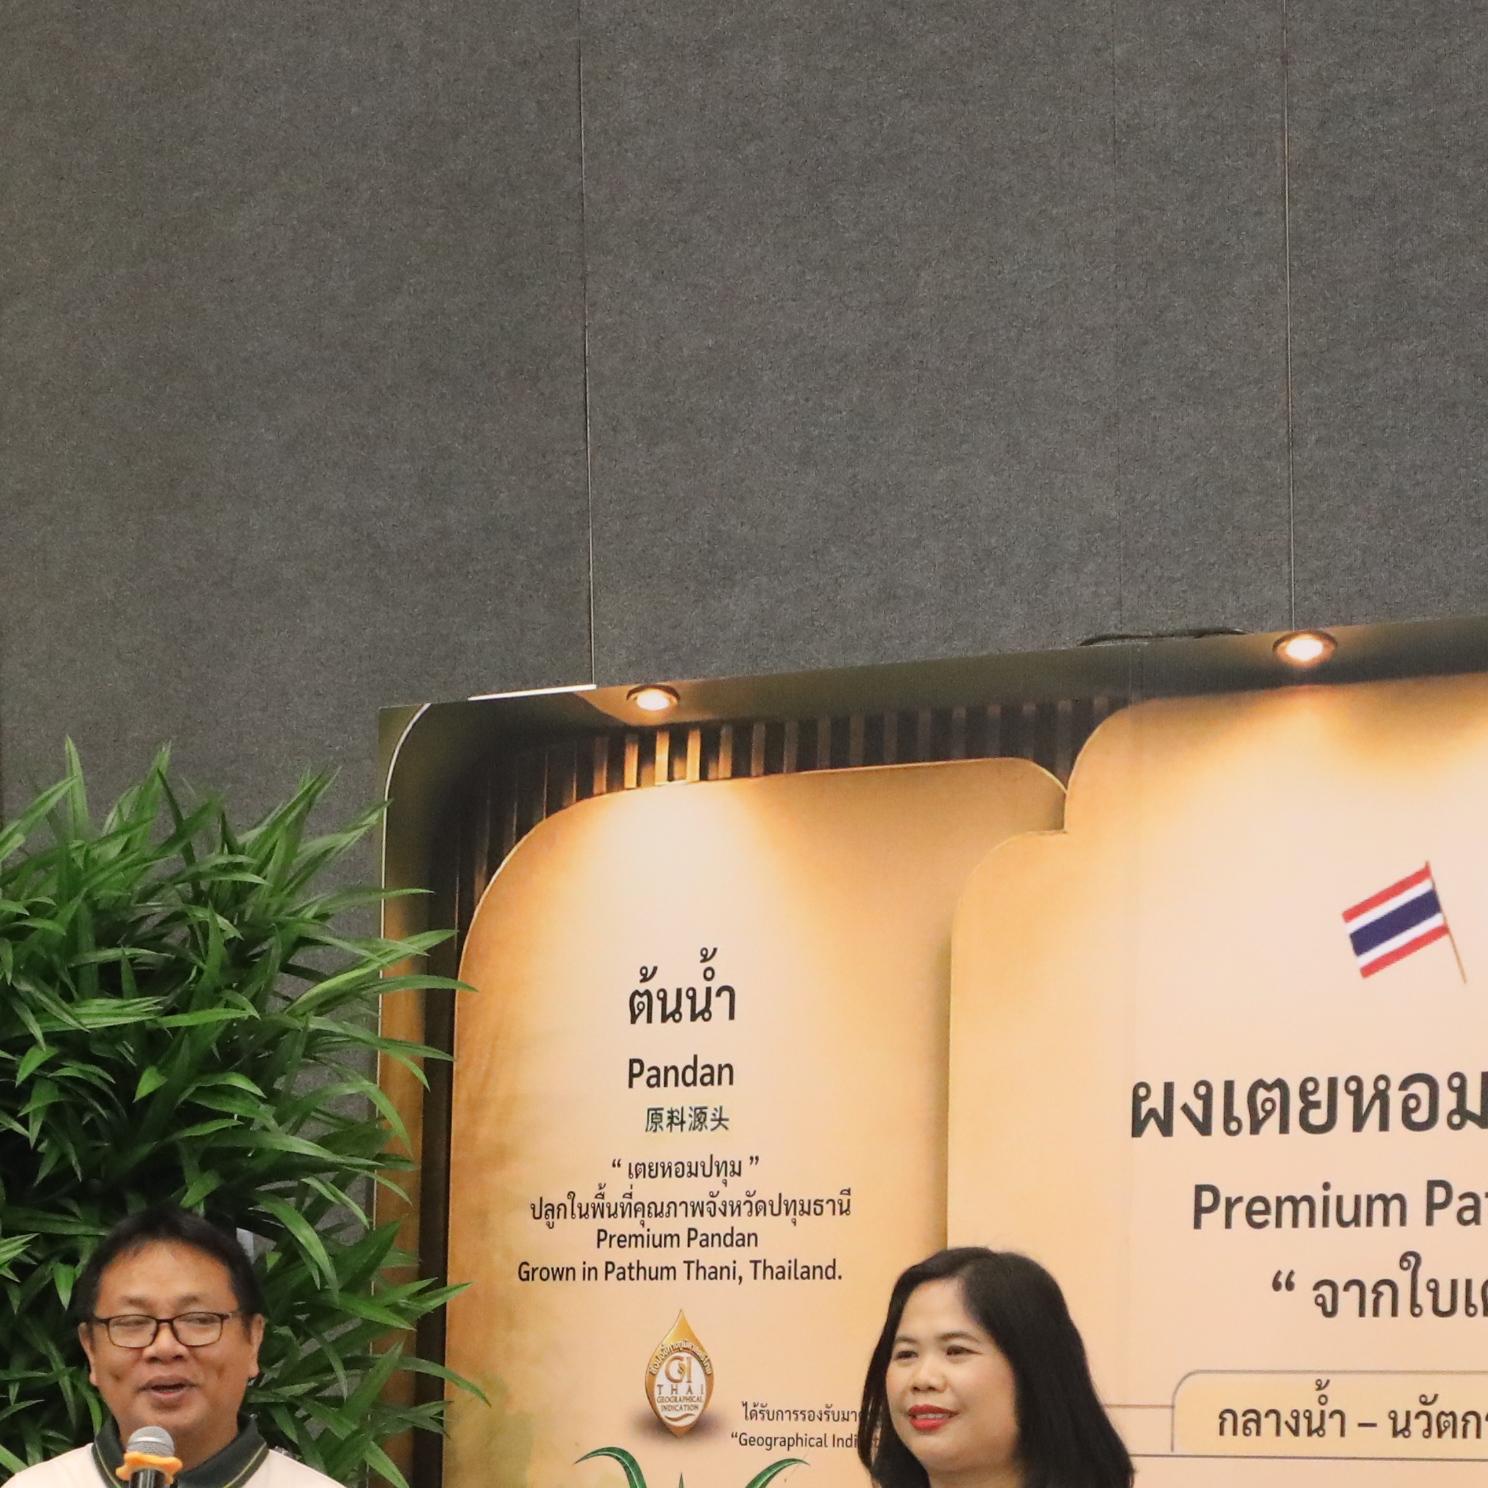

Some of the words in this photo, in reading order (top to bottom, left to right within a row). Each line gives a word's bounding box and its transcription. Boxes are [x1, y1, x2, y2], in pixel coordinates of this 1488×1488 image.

[628, 947, 736, 1025] ต้นน้ำ
[628, 1053, 734, 1089] Pandan
[645, 1105, 730, 1133] 原料源头
[628, 1153, 742, 1187] เตยหอมปทุม
[529, 1182, 851, 1229] ปลูกในพื้นที่คุณภาพจังหวัดปทุมธานี
[1193, 1181, 1407, 1230] Premium
[596, 1227, 681, 1249] Premium
[686, 1225, 758, 1248] Pandan
[517, 1260, 576, 1282] Grown
[582, 1260, 598, 1282] in
[604, 1259, 677, 1282] Pathum
[682, 1259, 743, 1285] Thani,
[749, 1257, 843, 1281] Thailand.
[665, 1355, 693, 1383] GI
[657, 1384, 704, 1395] THAI
[657, 1396, 703, 1404] GEOGRAPHICAL
[661, 1404, 699, 1412] INDICATION
[741, 1399, 863, 1425] ได้รับการรองรับมา
[1218, 1378, 1346, 1438] กลางน้ำ
